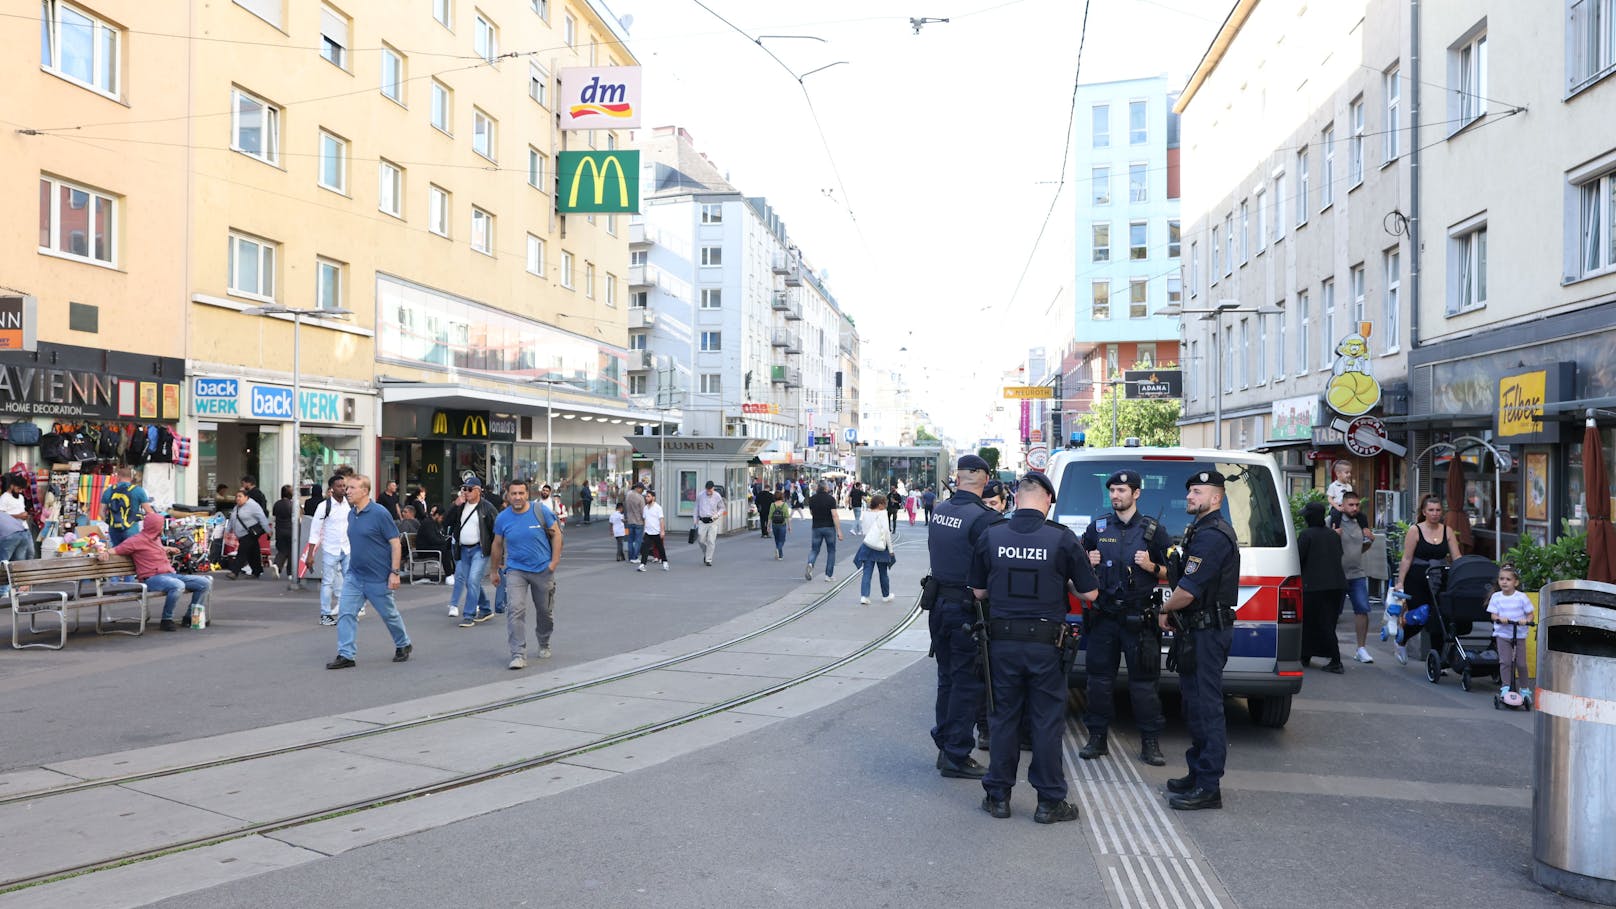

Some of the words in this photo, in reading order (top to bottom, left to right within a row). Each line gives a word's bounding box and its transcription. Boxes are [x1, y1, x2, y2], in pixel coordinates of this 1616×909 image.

[580, 76, 626, 103] dm
[197, 380, 236, 396] back
[5, 401, 31, 412] HOME
[33, 403, 82, 416] DECORATION
[195, 398, 238, 414] WERK
[253, 388, 292, 416] back
[299, 392, 340, 422] WERK
[1314, 428, 1344, 443] TABA
[1348, 432, 1378, 455] TRAFIK
[657, 441, 715, 450] BLUMEN
[932, 513, 963, 529] POLIZEI
[998, 546, 1048, 560] POLIZEI
